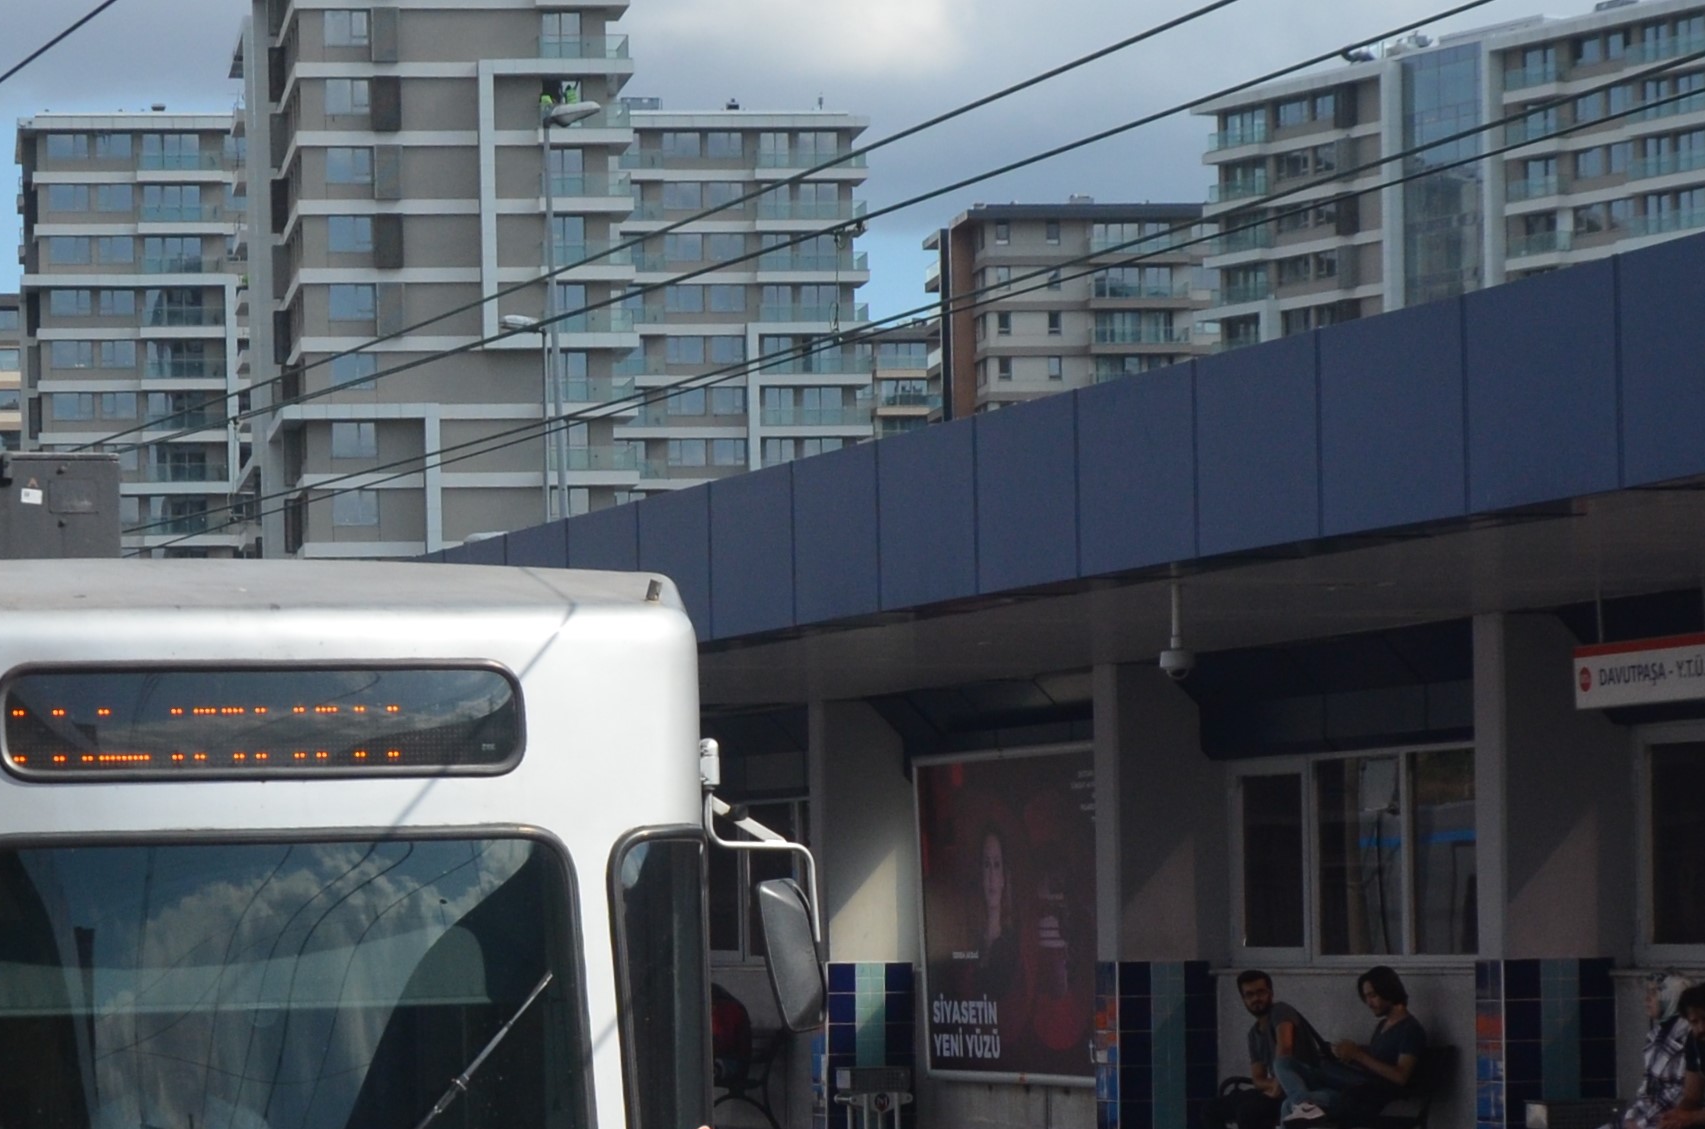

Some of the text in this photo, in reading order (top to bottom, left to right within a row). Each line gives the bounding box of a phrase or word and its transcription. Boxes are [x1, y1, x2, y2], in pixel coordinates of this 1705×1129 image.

[1599, 662, 1666, 686] DAVUTPAŞA
[932, 993, 998, 1025] SİYASETİN
[934, 1026, 1001, 1059] YENİ YÜZÜ
